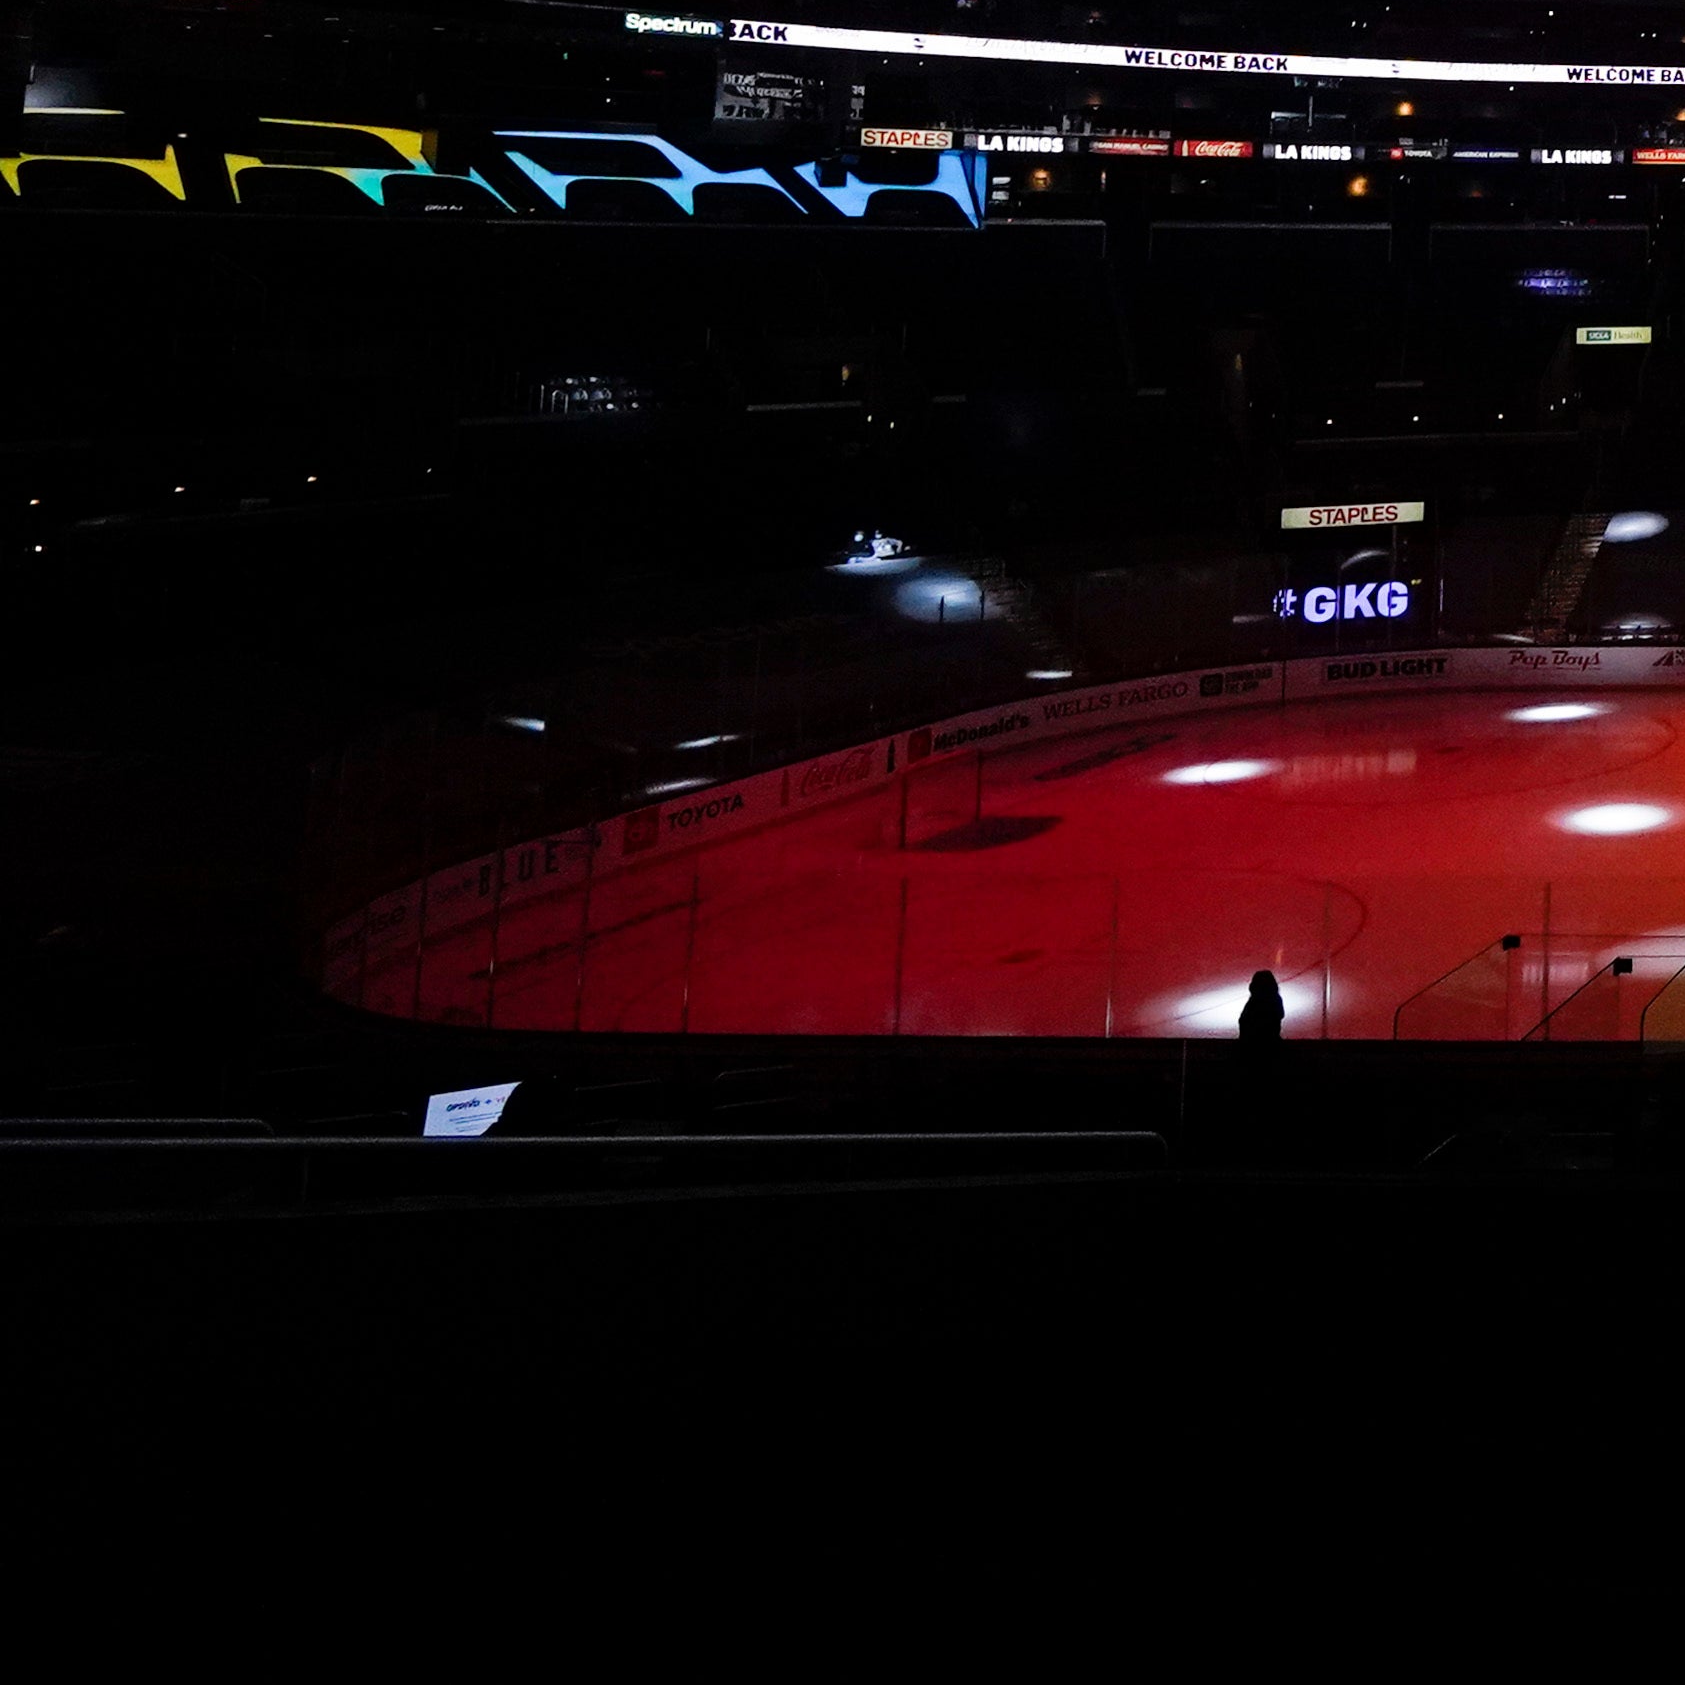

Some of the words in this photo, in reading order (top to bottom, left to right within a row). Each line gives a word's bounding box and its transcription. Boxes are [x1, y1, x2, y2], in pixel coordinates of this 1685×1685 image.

[624, 13, 718, 36] Spectrum
[1124, 49, 1228, 70] WELCOME
[1234, 54, 1288, 72] BACK
[1567, 67, 1656, 82] WELCOME
[863, 129, 949, 147] STAPLES
[977, 134, 1004, 152] LA
[1007, 135, 1064, 153] KINGS
[1194, 141, 1243, 158] Coca-Cola
[1274, 144, 1298, 159] LA
[1301, 145, 1352, 160] KINGS
[1541, 149, 1563, 164] LA
[1565, 150, 1612, 164] KINGS
[1309, 505, 1398, 526] STAPLES
[1328, 661, 1377, 681] BUD
[1380, 658, 1448, 677] LIGHT
[1509, 650, 1548, 670] Pep
[1552, 650, 1601, 672] Boys
[1043, 694, 1112, 720] WELLS
[1118, 681, 1188, 706] FARGO
[934, 714, 1029, 752] McDonald's
[667, 794, 744, 830] TOYOTA
